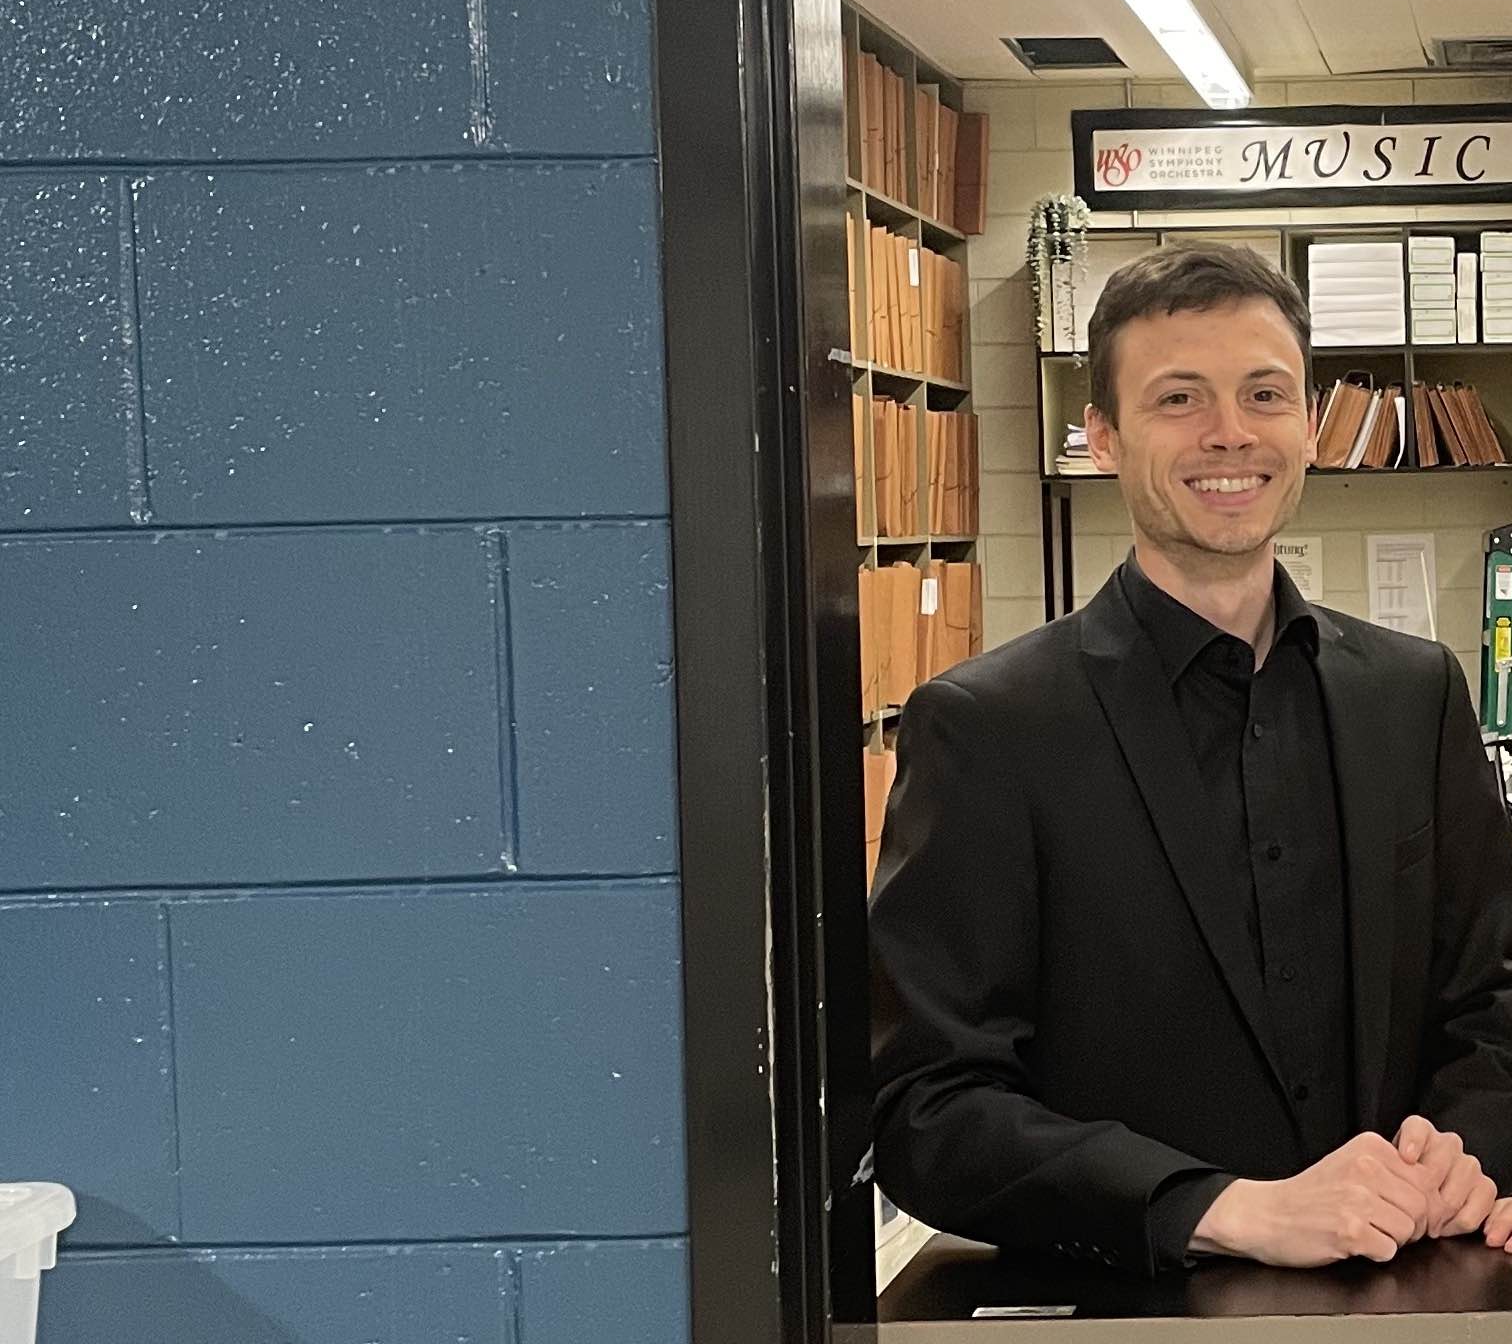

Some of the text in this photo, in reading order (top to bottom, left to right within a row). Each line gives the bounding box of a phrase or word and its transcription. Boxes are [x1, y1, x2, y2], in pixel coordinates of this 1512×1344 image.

[1148, 145, 1223, 156] WINNIPEG
[1240, 131, 1491, 182] MUSIC
[1149, 157, 1223, 168] SYMPHONY
[1149, 168, 1224, 179] ORCHESTRA
